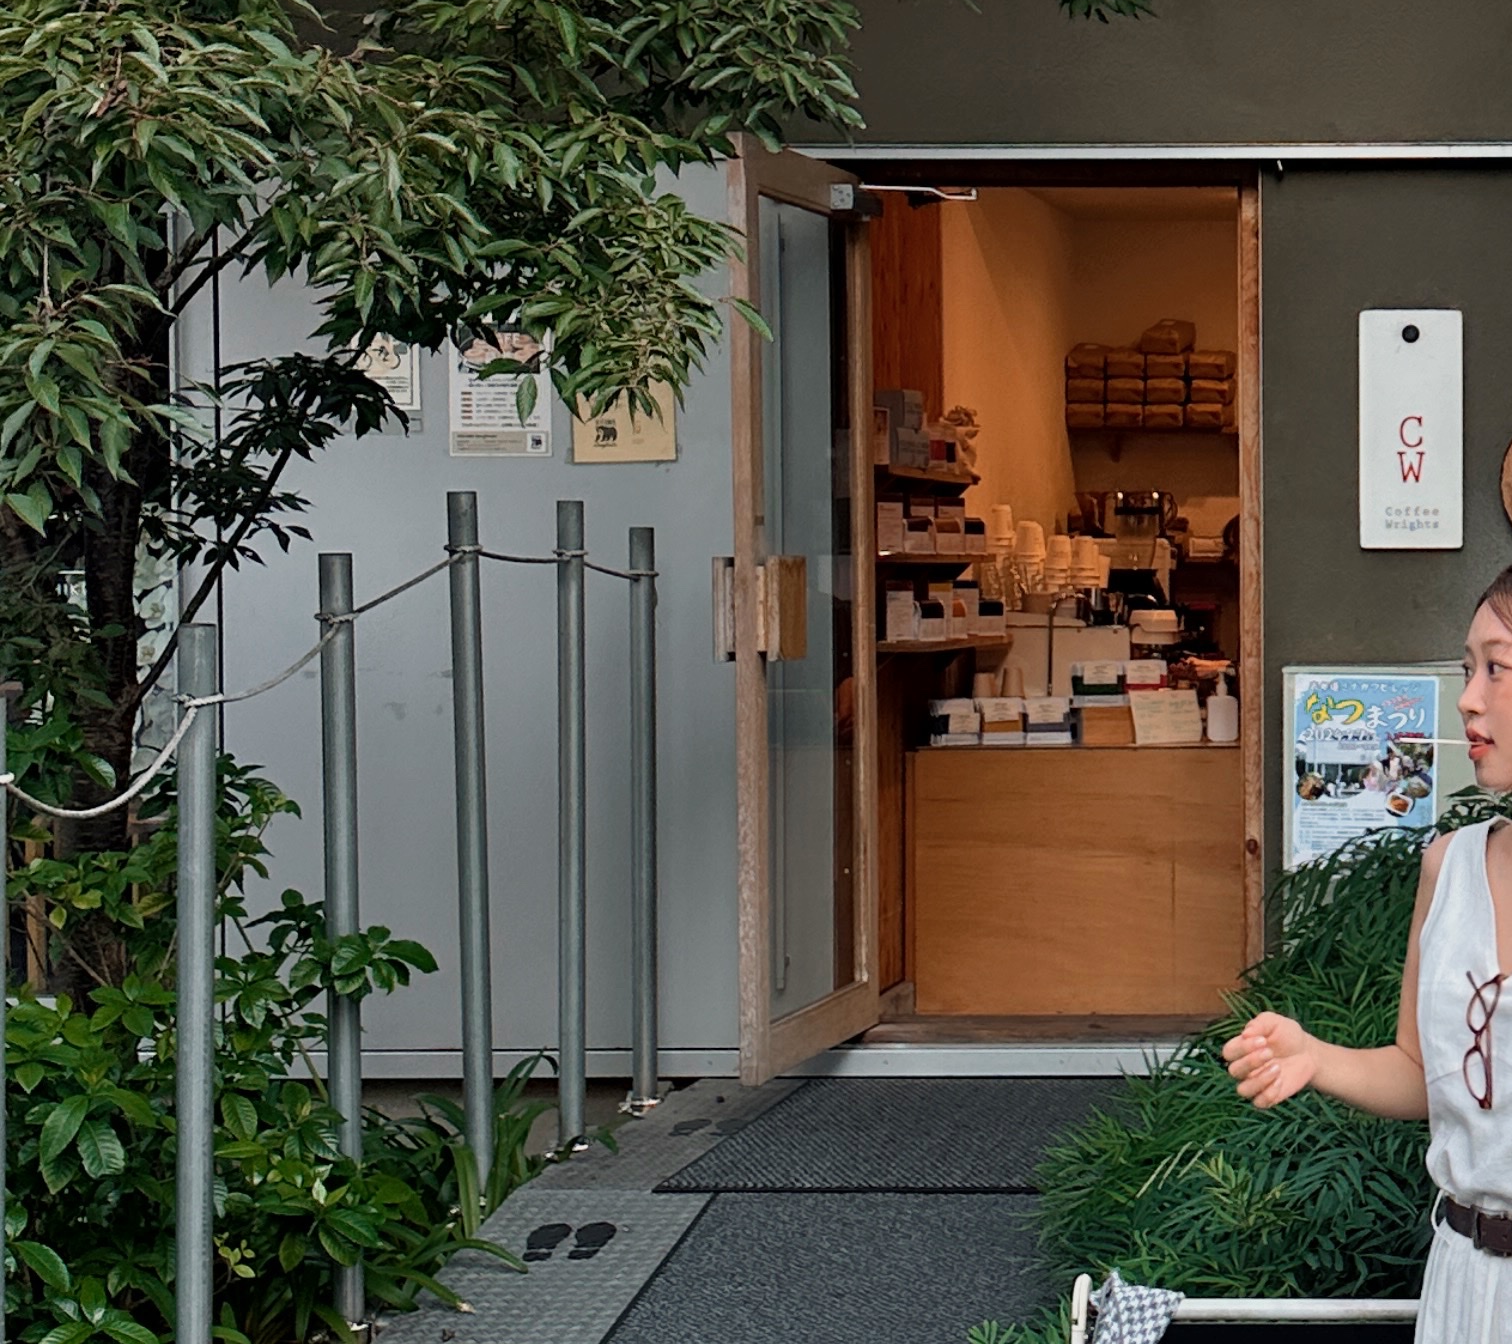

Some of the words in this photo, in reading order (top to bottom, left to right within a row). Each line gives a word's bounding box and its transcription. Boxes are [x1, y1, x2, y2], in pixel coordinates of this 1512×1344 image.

[1384, 506, 1440, 517] Coffee
[1384, 519, 1440, 531] Wrights
[1305, 692, 1365, 725] なつ
[1366, 704, 1426, 730] まつり
